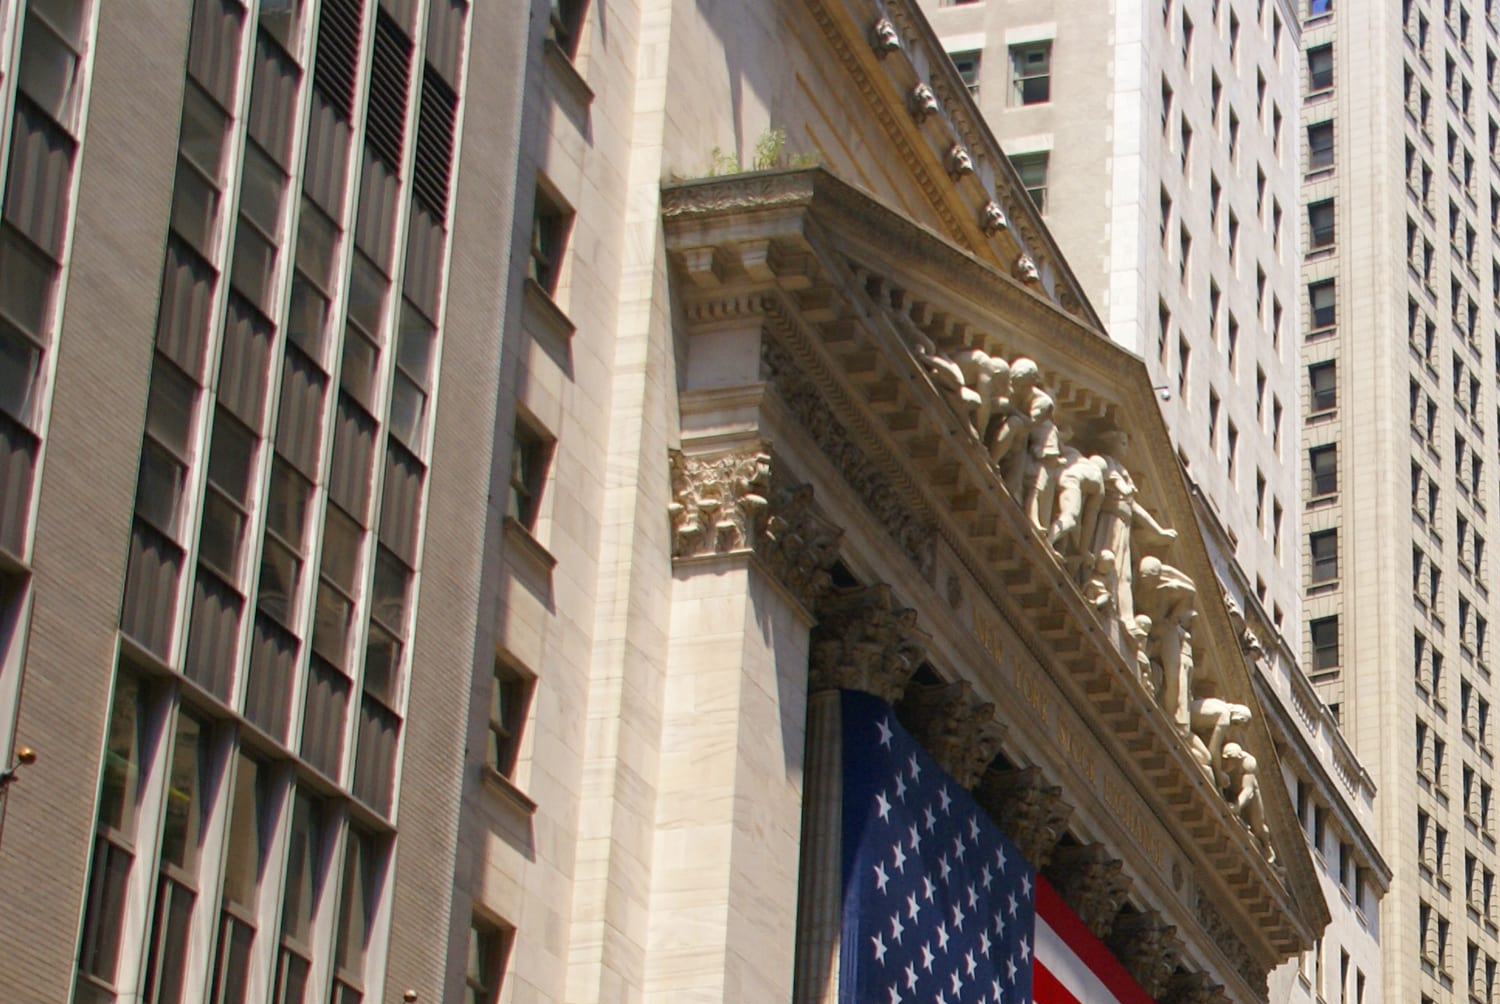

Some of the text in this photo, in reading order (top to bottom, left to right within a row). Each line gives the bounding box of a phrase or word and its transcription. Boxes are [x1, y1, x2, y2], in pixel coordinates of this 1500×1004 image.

[973, 605, 1003, 664] NEW
[1013, 655, 1049, 723] YORK
[1057, 717, 1096, 787] STOCK
